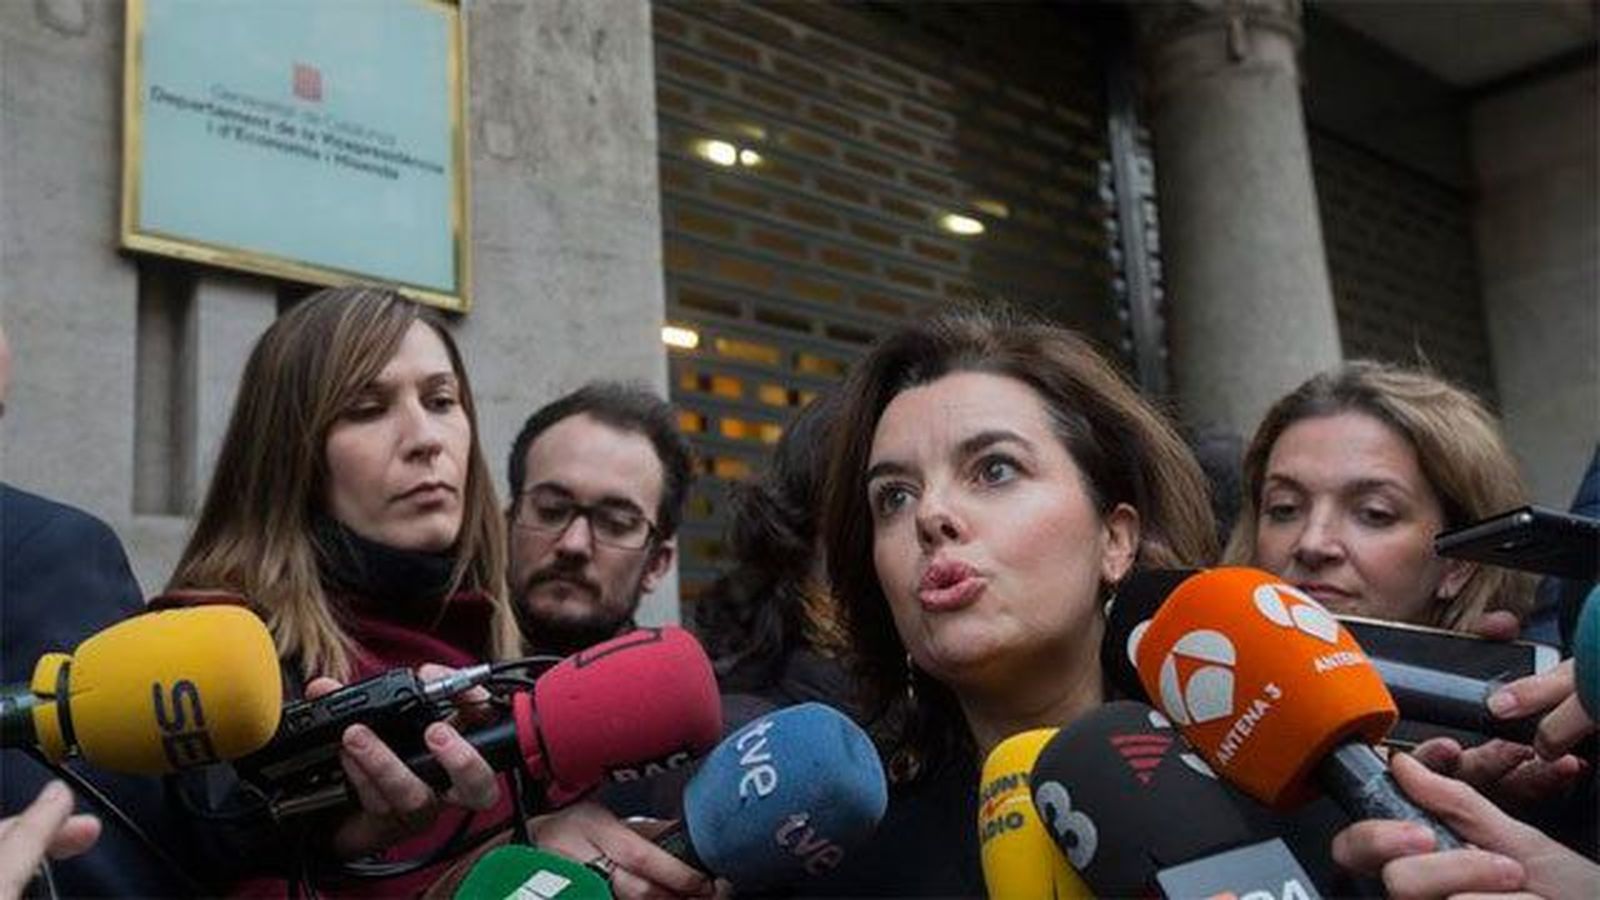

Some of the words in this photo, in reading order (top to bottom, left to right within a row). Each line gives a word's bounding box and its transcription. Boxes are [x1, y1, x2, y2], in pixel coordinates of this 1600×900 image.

[736, 719, 778, 802] tve
[1215, 699, 1271, 766] ANTENA
[1264, 682, 1283, 700] 3
[775, 811, 846, 876] tve
